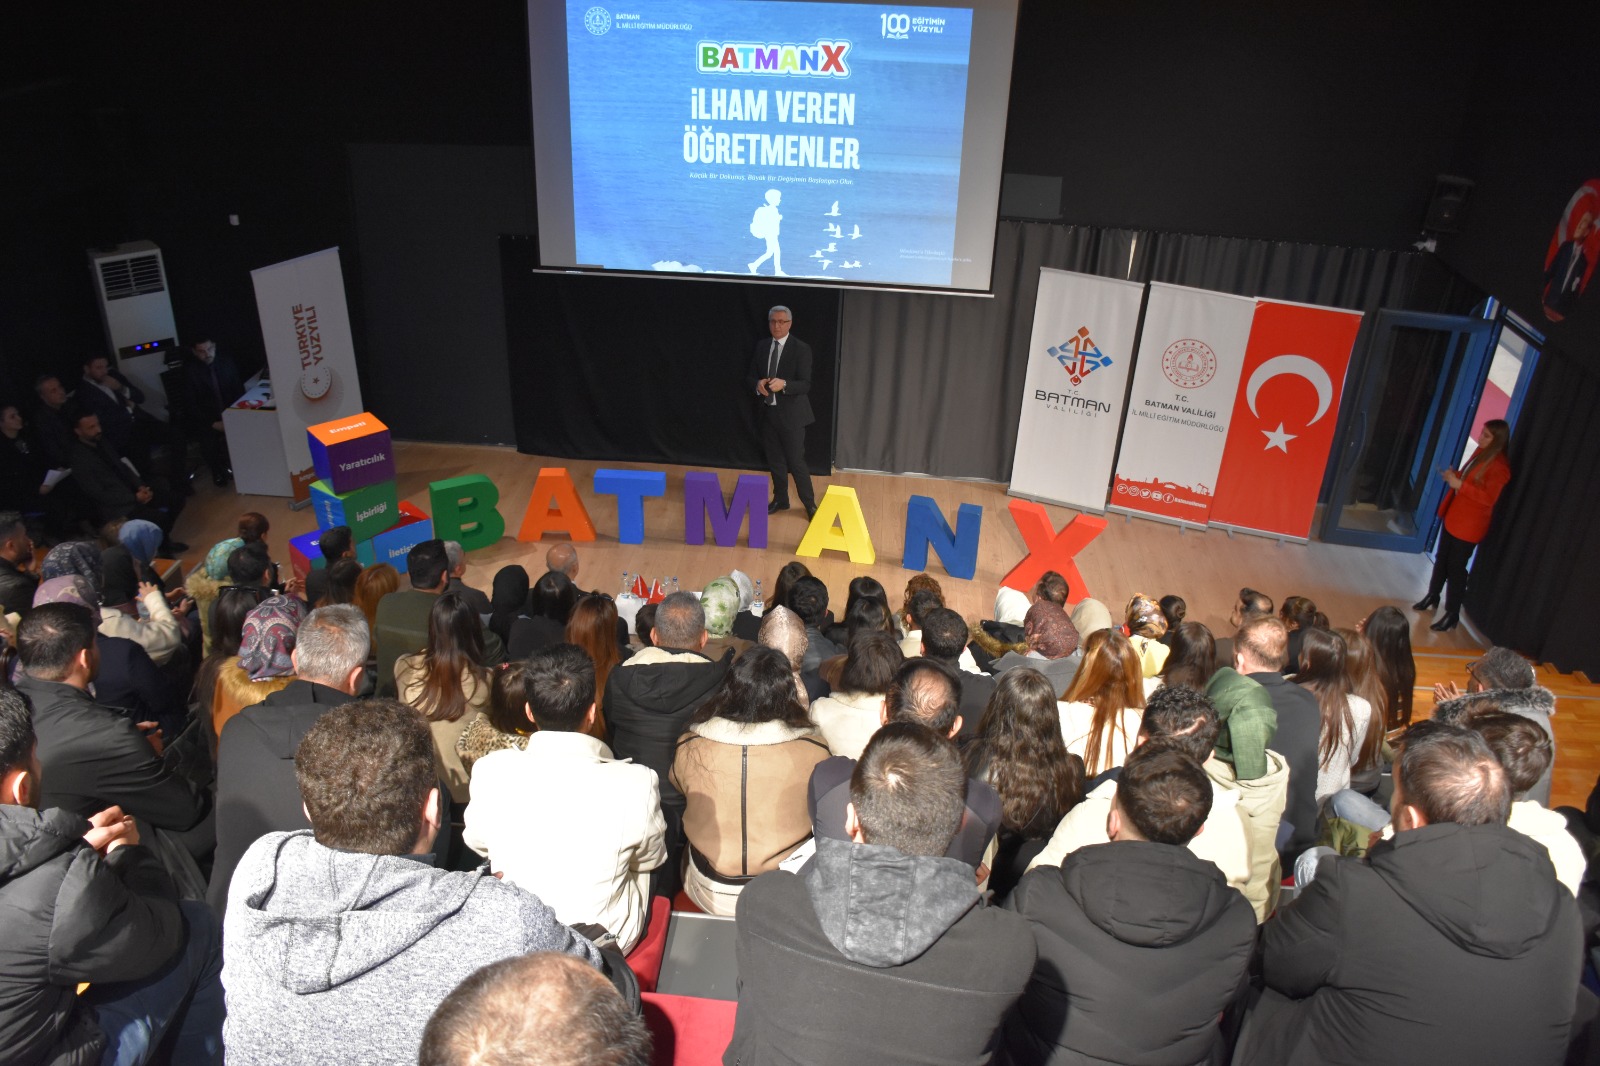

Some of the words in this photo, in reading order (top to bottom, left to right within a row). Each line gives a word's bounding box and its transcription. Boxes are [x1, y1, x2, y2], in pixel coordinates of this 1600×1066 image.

[880, 13, 910, 37] 100
[911, 17, 946, 25] EĞİTİMİN
[912, 25, 943, 33] YÜZYILI
[702, 45, 846, 72] BATMANX
[691, 88, 768, 122] İLHAM
[775, 90, 856, 126] VEREN
[683, 125, 860, 170] ÖĞRETMENLER
[1035, 389, 1111, 413] BATMAN
[1175, 394, 1189, 403] T.C.
[1144, 399, 1180, 412] BATMAN
[1181, 406, 1217, 419] VALİLİĞİ
[329, 421, 367, 434] Empati
[1138, 410, 1156, 419] MİLLİ
[1156, 414, 1180, 424] EĞİTİM
[1180, 418, 1225, 433] MÜDÜRLÜĞÜ
[339, 453, 386, 472] Yaratıcılık
[356, 502, 387, 522] İşbirliği
